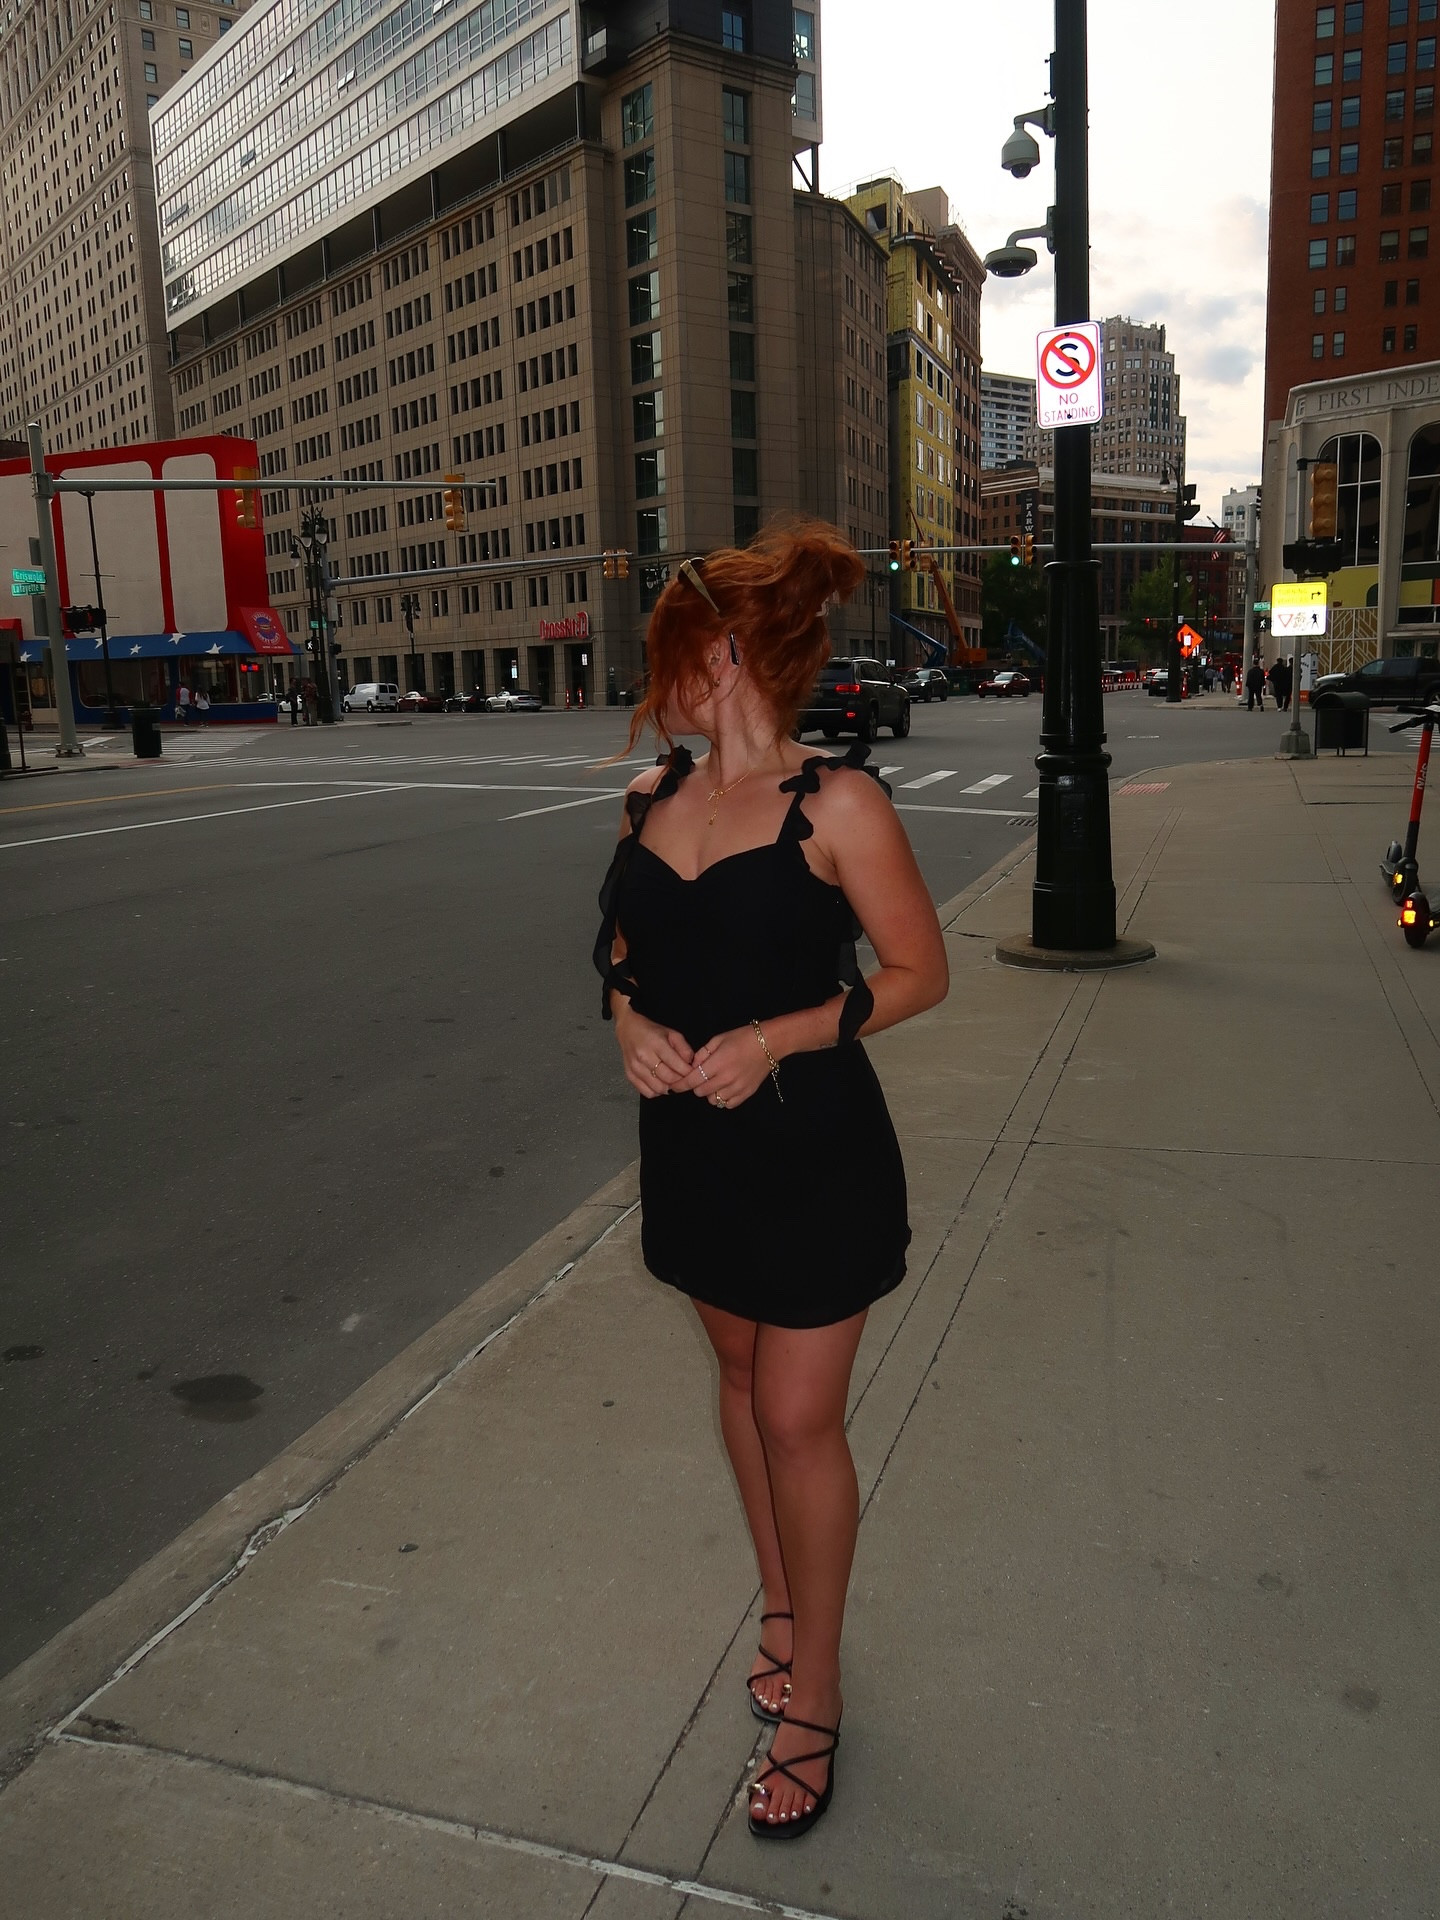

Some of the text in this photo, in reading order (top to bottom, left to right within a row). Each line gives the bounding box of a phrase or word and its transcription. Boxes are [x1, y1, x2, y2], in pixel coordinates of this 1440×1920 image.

[1059, 393, 1079, 406] NO
[1318, 375, 1440, 411] FIRST INDE
[1044, 406, 1096, 423] STANDING
[15, 571, 43, 581] Griswold
[540, 618, 577, 640] CrossFit
[1417, 763, 1427, 790] SPIN
